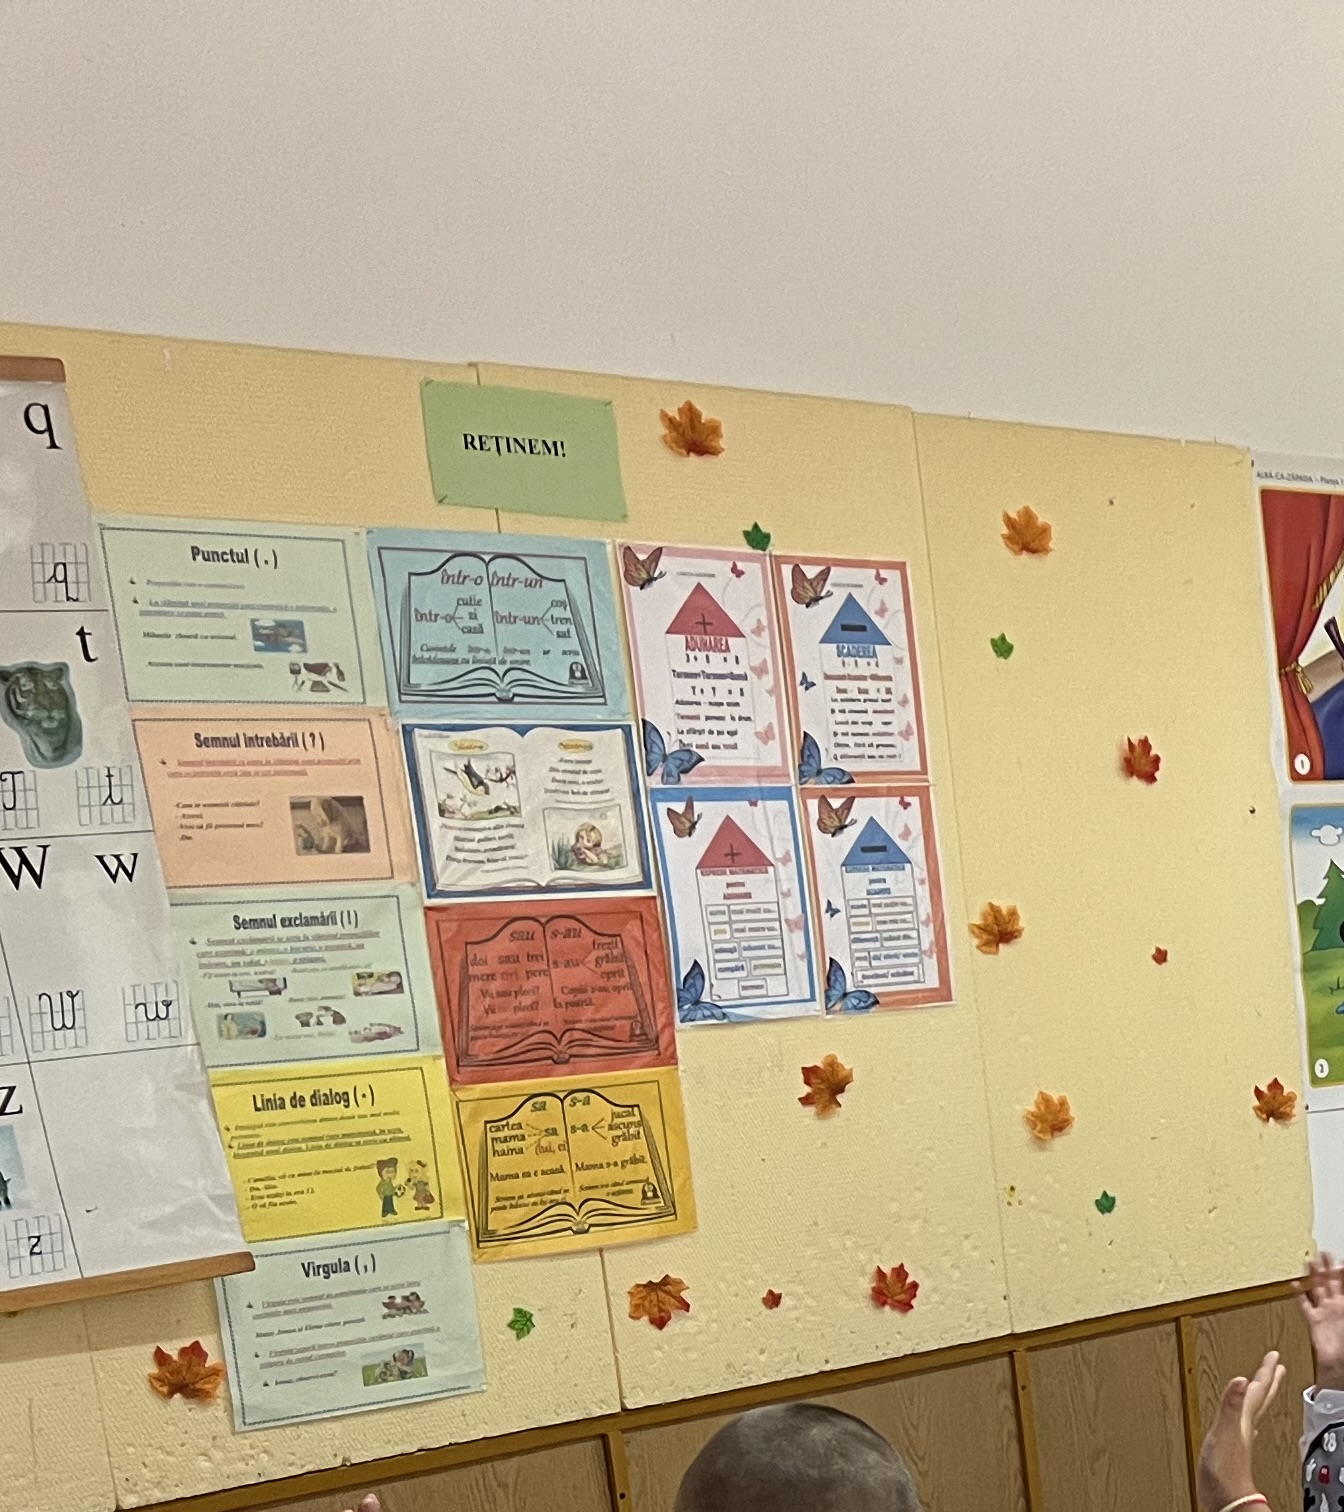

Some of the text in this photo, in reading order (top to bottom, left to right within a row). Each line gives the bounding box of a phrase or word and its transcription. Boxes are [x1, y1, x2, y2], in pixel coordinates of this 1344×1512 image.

[23, 402, 62, 450] q
[462, 431, 567, 459] REȚINEM!
[191, 546, 249, 564] Punctul
[76, 625, 98, 662] t
[194, 732, 241, 748] Semnul
[233, 914, 277, 930] Semnul
[252, 1093, 286, 1112] Linia
[290, 1091, 306, 1109] de
[310, 1088, 350, 1109] dialog
[301, 1257, 350, 1279] Virgula
